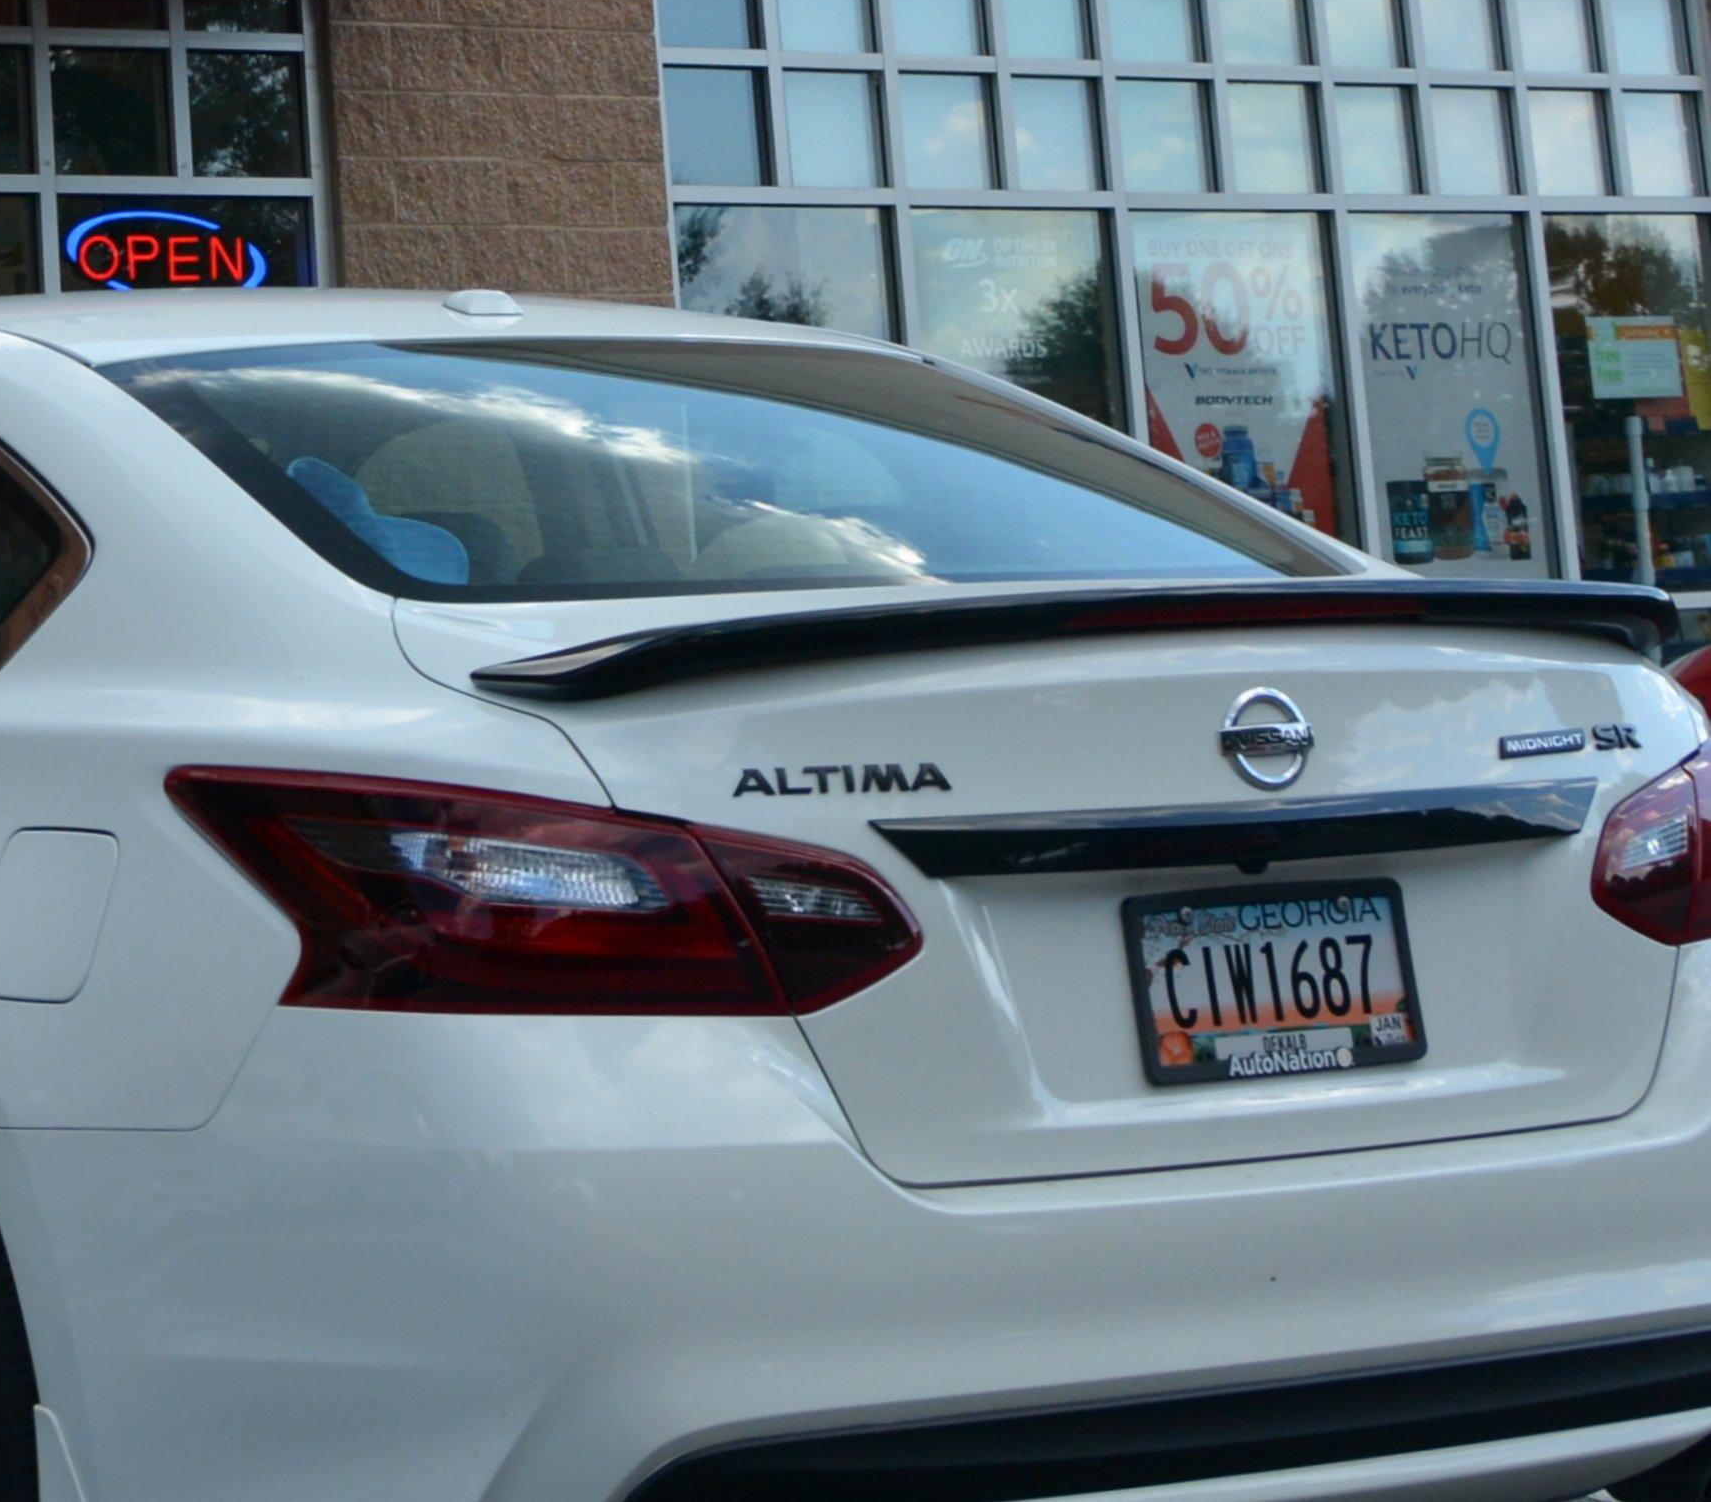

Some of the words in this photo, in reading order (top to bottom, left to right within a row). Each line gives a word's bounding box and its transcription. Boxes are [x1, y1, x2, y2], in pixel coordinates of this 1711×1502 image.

[78, 234, 245, 283] OPEN
[1148, 239, 1181, 257] BUY
[1185, 239, 1220, 258] ONE
[1225, 240, 1256, 258] GET
[1259, 240, 1294, 258] ONE
[1151, 261, 1303, 356] 50%
[959, 337, 1049, 358] AWARDS
[1256, 324, 1305, 355] OFF
[1195, 395, 1274, 406] BODYTECH
[1394, 526, 1429, 540] FEAST
[1233, 728, 1310, 750] NISSAN
[1507, 733, 1583, 752] MIDNIGHT
[1591, 724, 1642, 751] SR
[732, 762, 953, 798] ALTIMA
[1237, 897, 1382, 931] GEORGIA
[1164, 933, 1373, 1030] CIW1687
[1376, 1016, 1402, 1032] JAN
[1262, 1033, 1307, 1055] DEKALB
[1229, 1050, 1337, 1078] AutoNation
